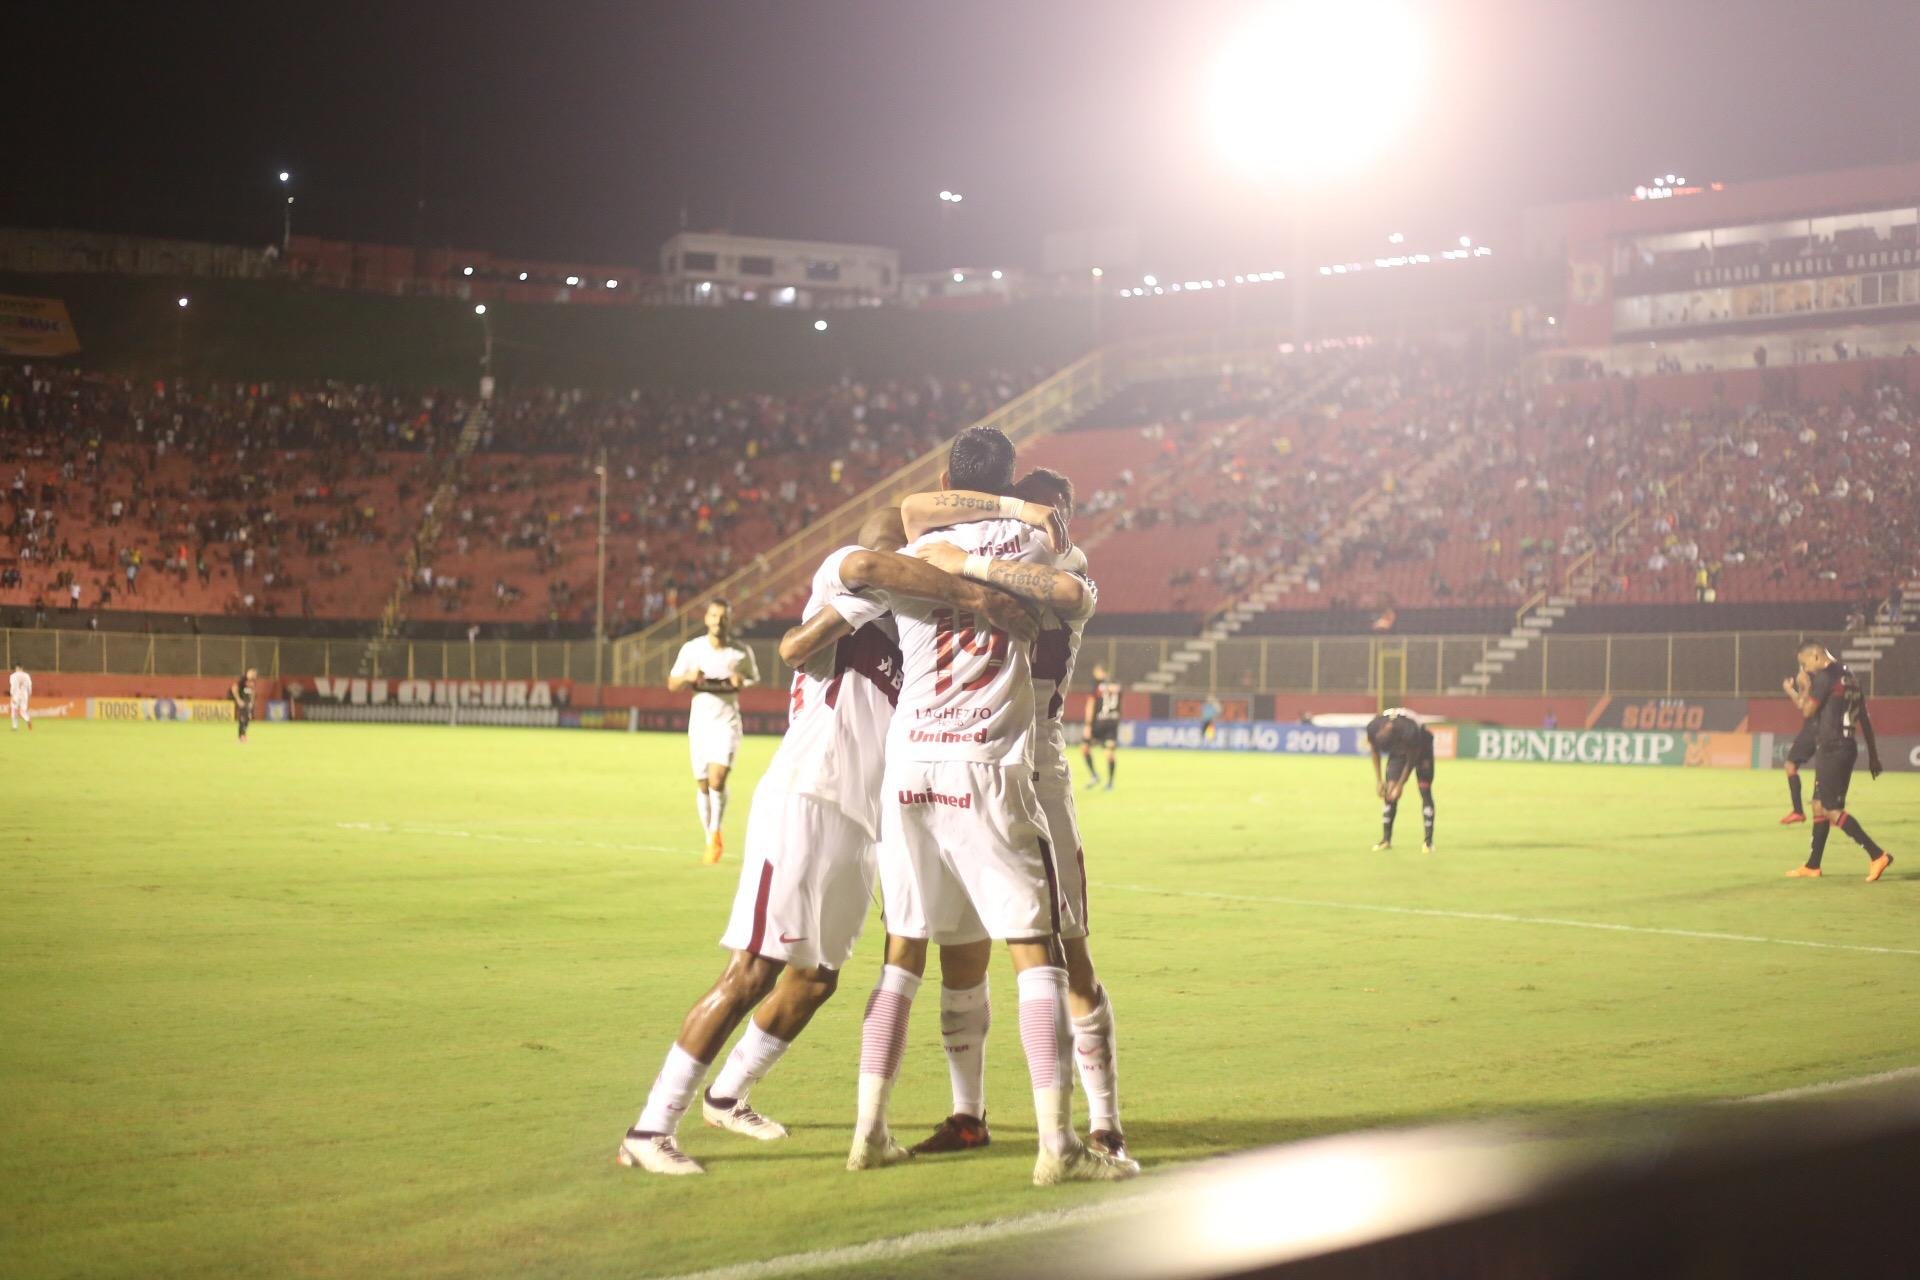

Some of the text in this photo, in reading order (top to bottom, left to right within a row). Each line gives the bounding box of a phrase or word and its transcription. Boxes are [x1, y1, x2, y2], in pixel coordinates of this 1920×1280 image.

[968, 534, 1021, 557] nrisul
[99, 701, 138, 720] TODOS
[915, 707, 992, 719] LAGHETTO
[1622, 700, 1704, 729] SÓCIO
[909, 728, 988, 744] Unimed
[1286, 730, 1341, 753] 2018
[1477, 729, 1674, 764] BENEGRIP
[898, 786, 972, 809] Unimed
